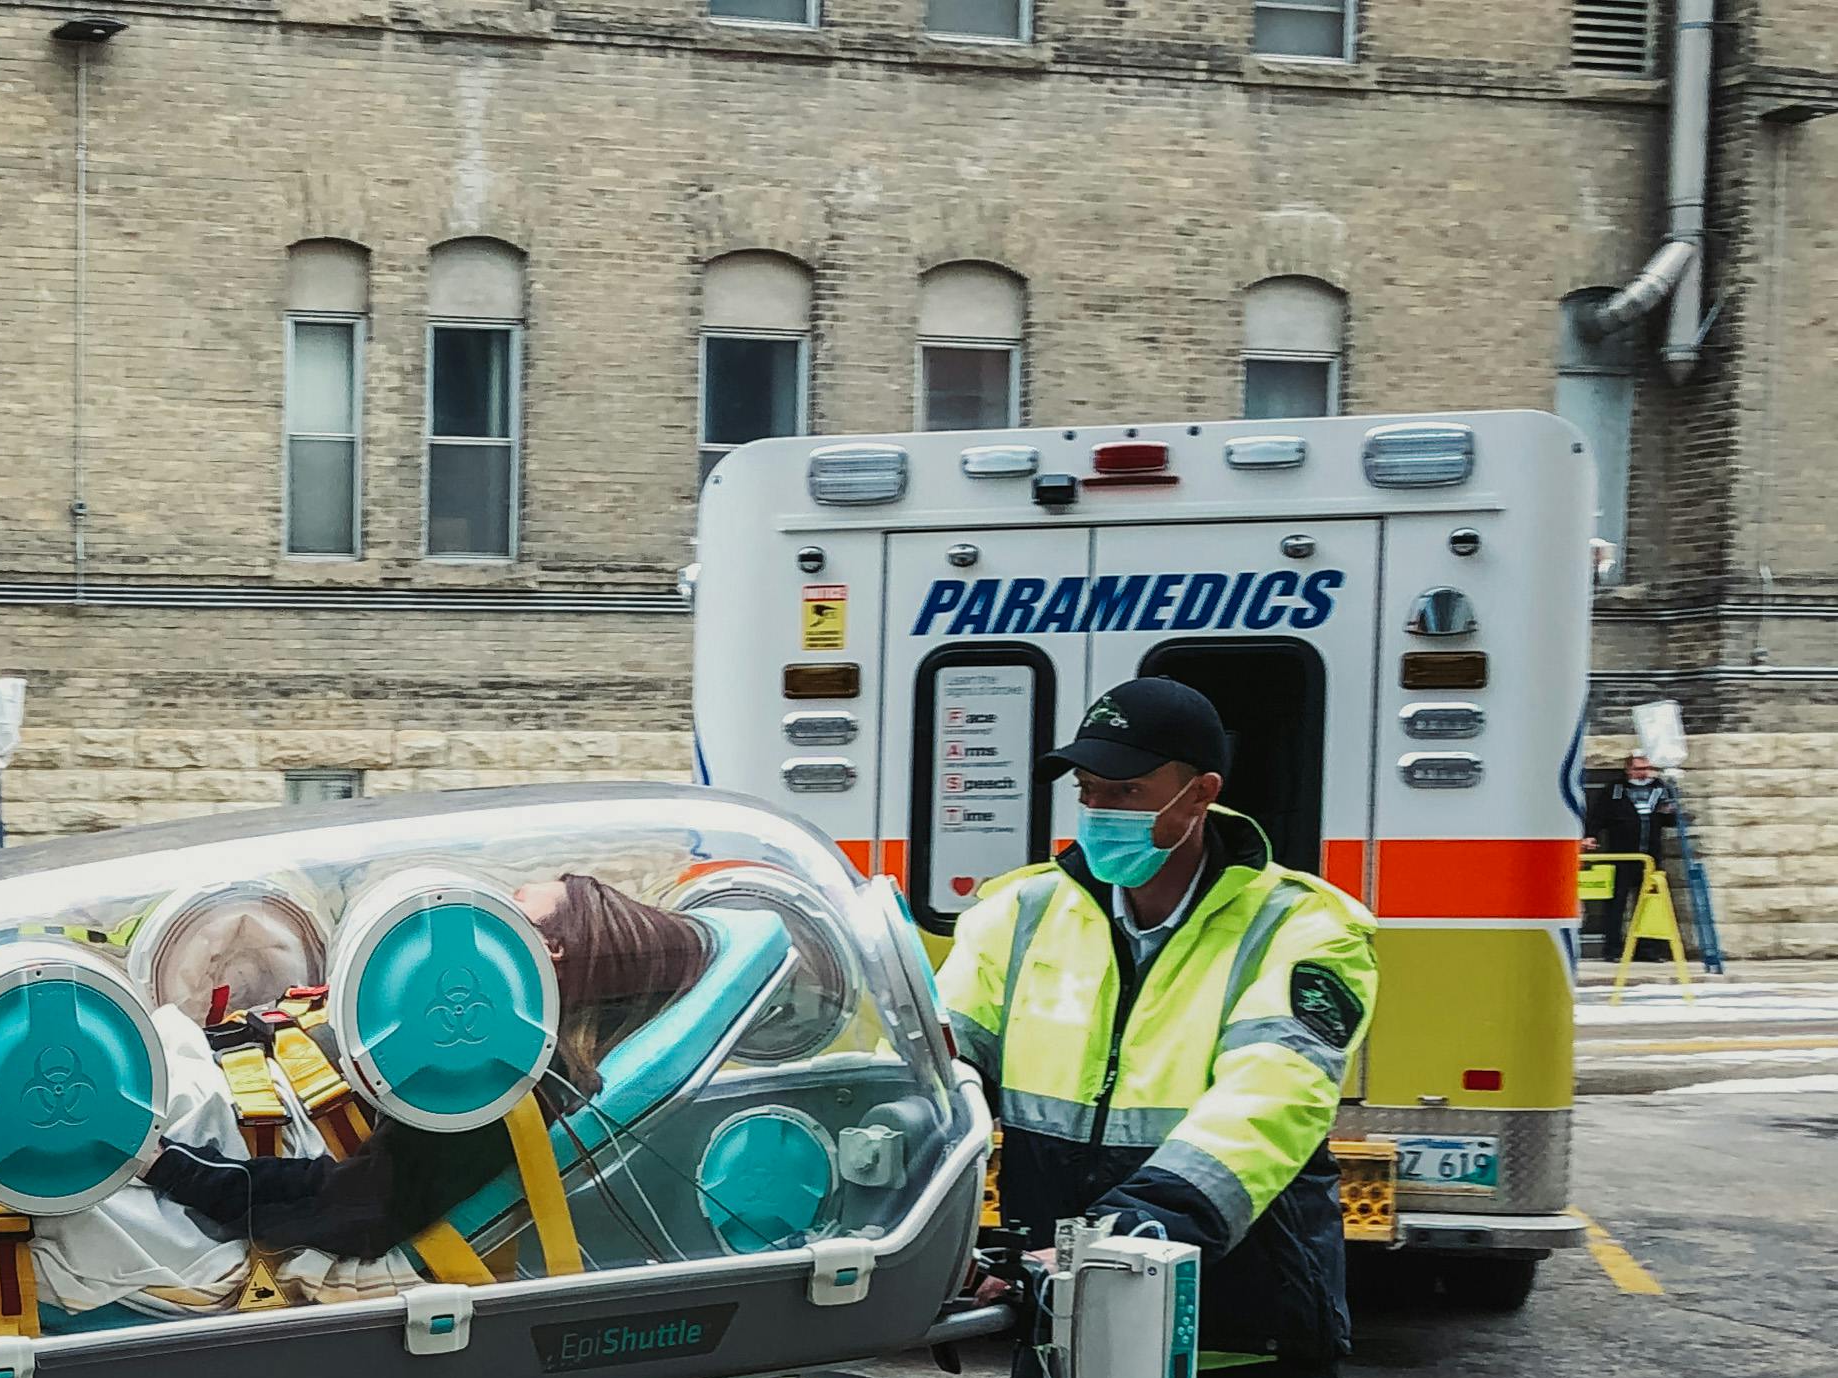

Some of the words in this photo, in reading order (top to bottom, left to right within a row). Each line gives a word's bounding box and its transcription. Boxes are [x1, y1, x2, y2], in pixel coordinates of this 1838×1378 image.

[909, 569, 1346, 636] PARAMEDICS
[1438, 1152, 1491, 1178] 619
[561, 1319, 703, 1363] EpiShuttle
